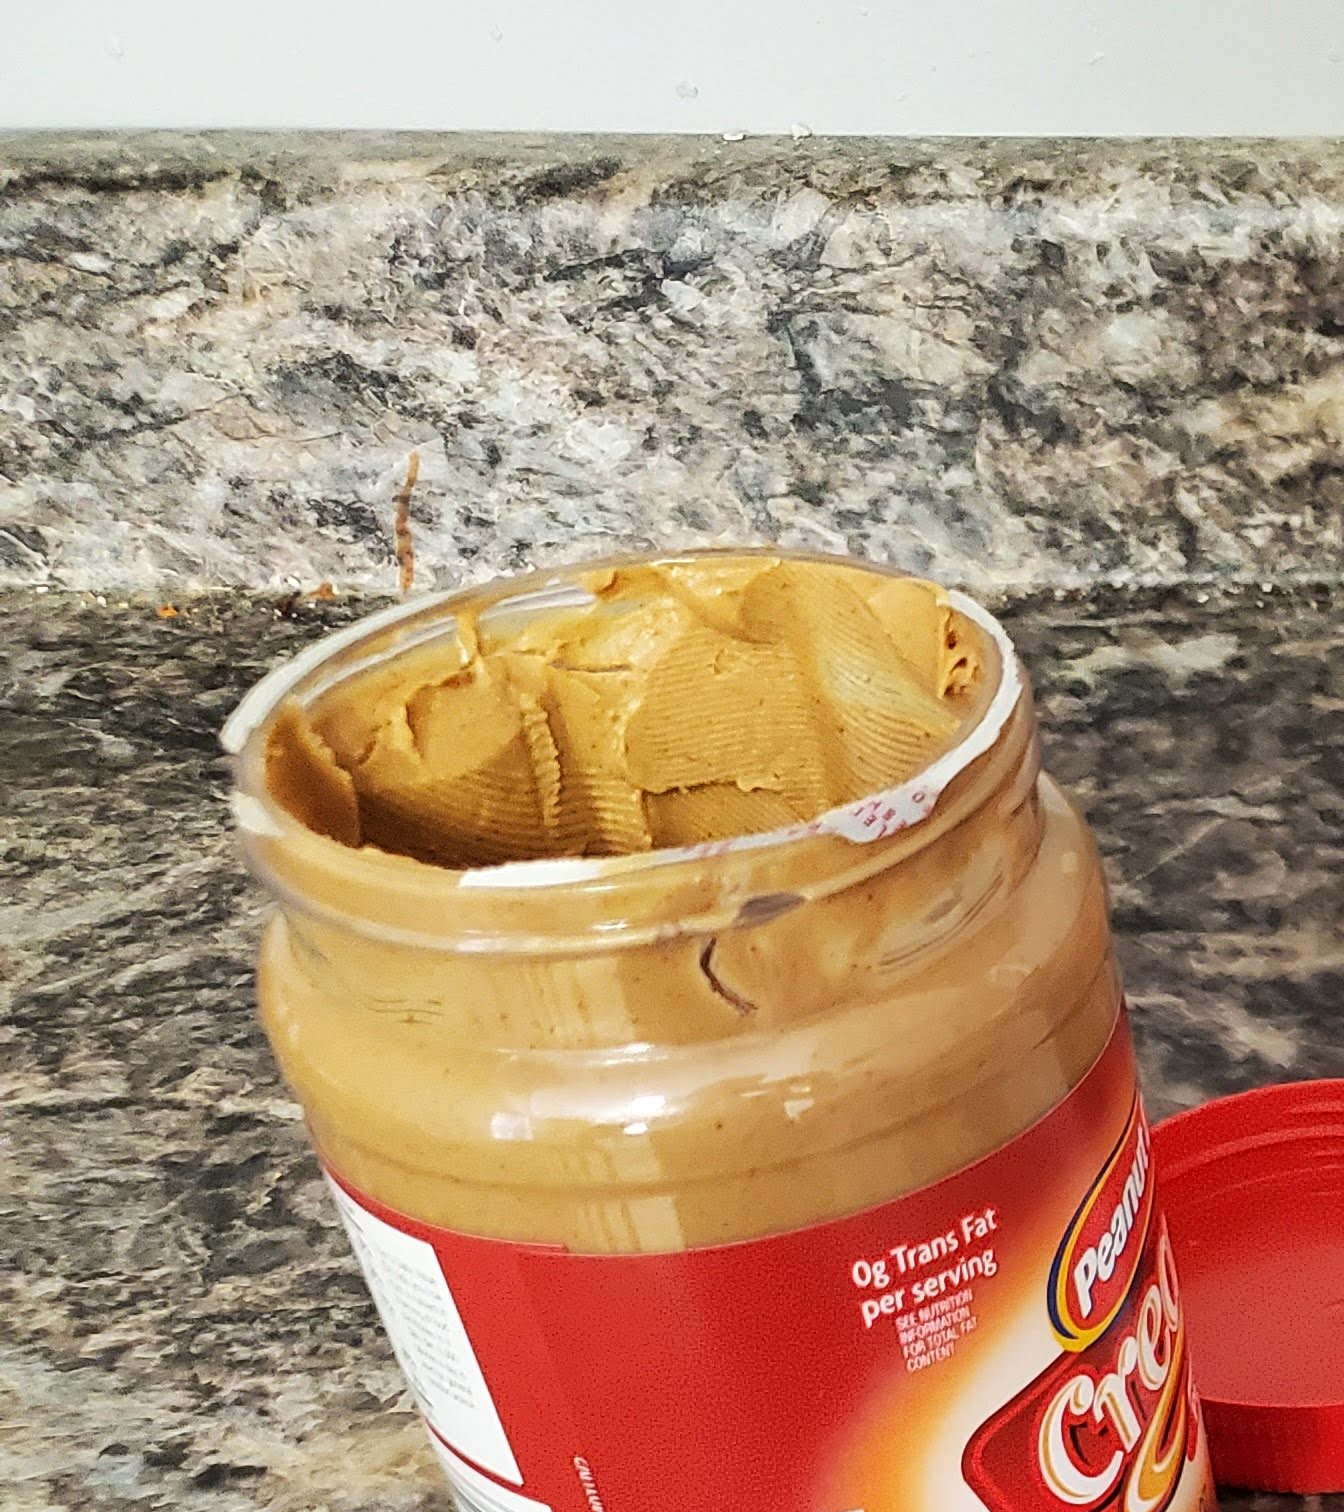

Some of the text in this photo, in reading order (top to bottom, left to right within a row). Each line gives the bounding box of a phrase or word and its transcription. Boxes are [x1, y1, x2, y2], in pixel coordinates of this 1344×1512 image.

[852, 1208, 998, 1289] 0g Trans Fat
[862, 1249, 998, 1329] per serving
[895, 1288, 973, 1330] SEE NUTRITION
[900, 1305, 971, 1344] INFORMATION
[903, 1316, 977, 1360] FOR TOTAL FAT
[906, 1341, 956, 1372] CONTENT
